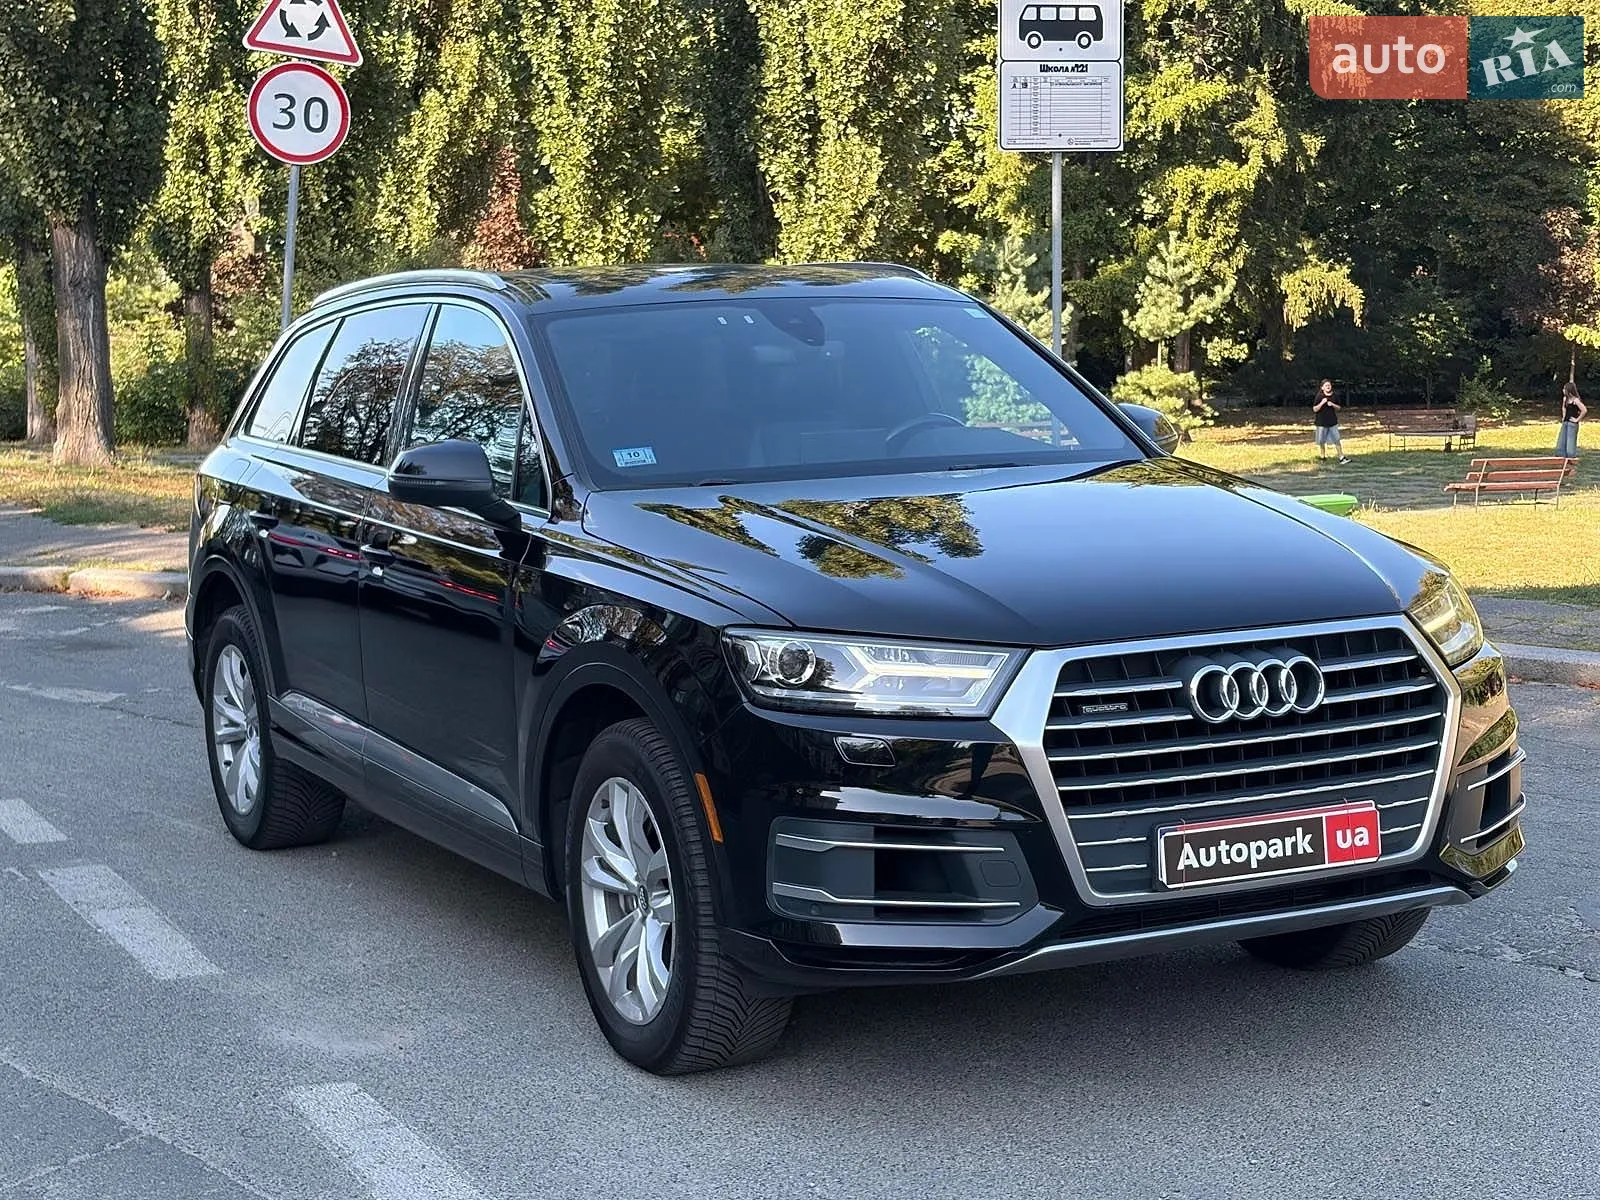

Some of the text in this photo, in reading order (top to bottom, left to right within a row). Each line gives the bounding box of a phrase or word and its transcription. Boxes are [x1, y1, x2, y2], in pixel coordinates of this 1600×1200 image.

[272, 93, 329, 133] 30
[1176, 825, 1370, 871] Autopark ua
